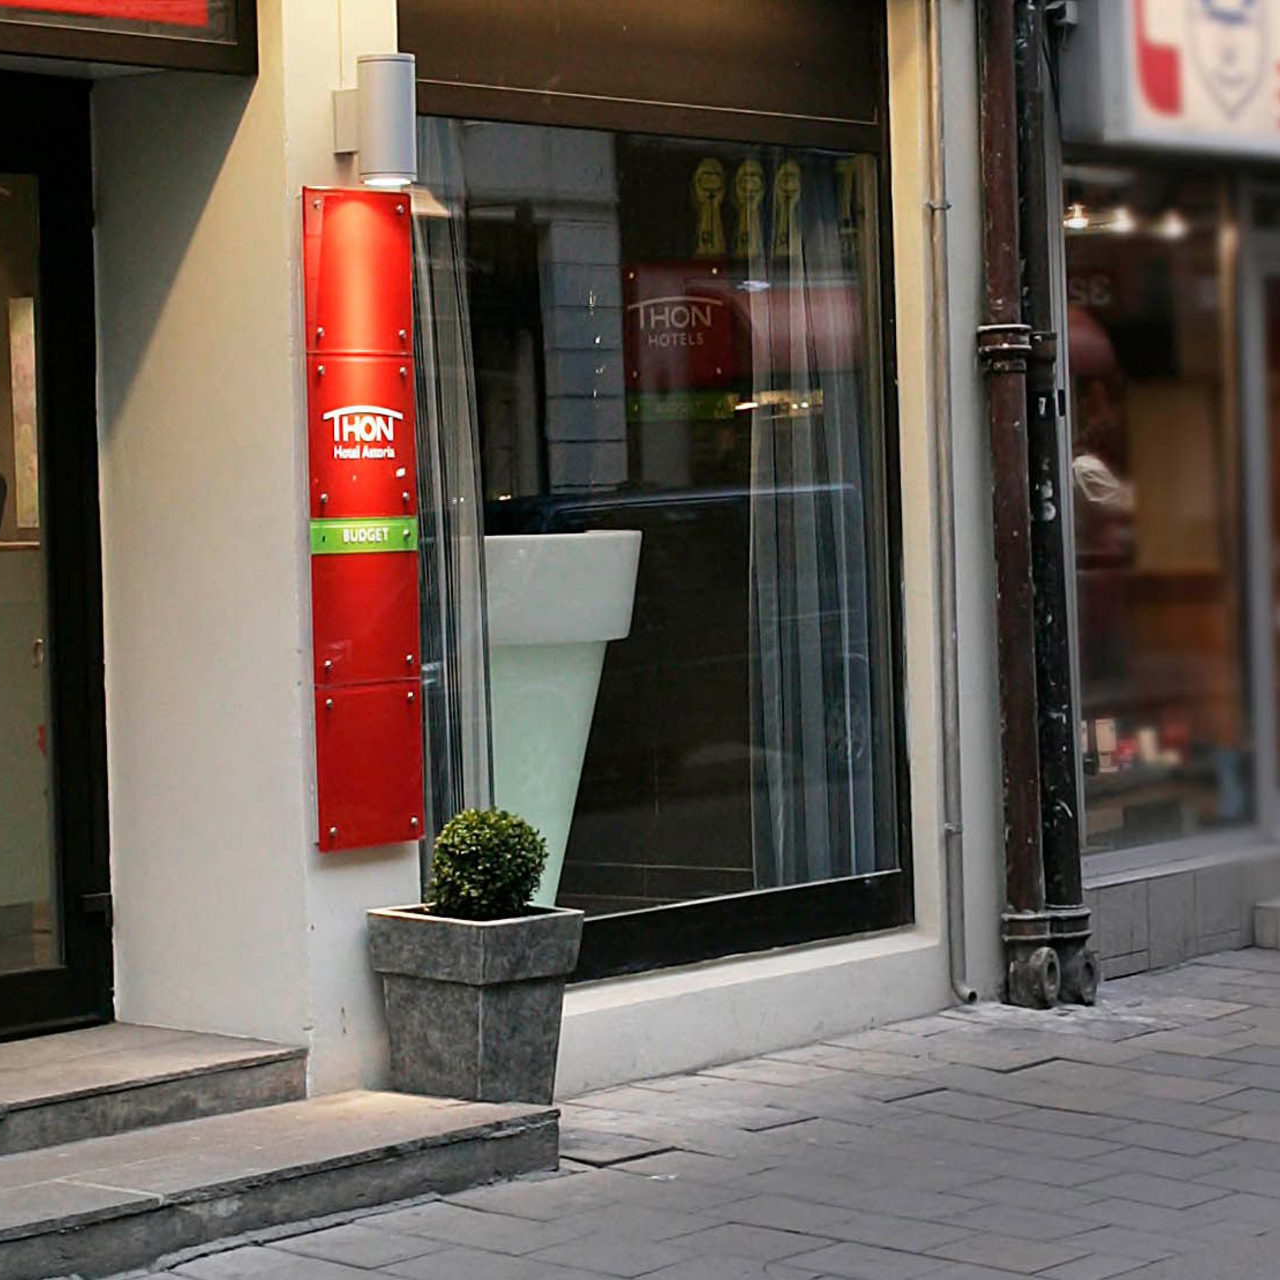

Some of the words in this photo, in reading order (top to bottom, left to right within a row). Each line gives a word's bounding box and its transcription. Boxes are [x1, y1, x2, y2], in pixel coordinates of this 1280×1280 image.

[628, 295, 723, 330] THON
[648, 330, 705, 347] HOTELS
[323, 405, 404, 442] THON
[333, 445, 360, 459] Hotel
[362, 444, 396, 459] Astoria
[343, 527, 389, 544] BUDGET
